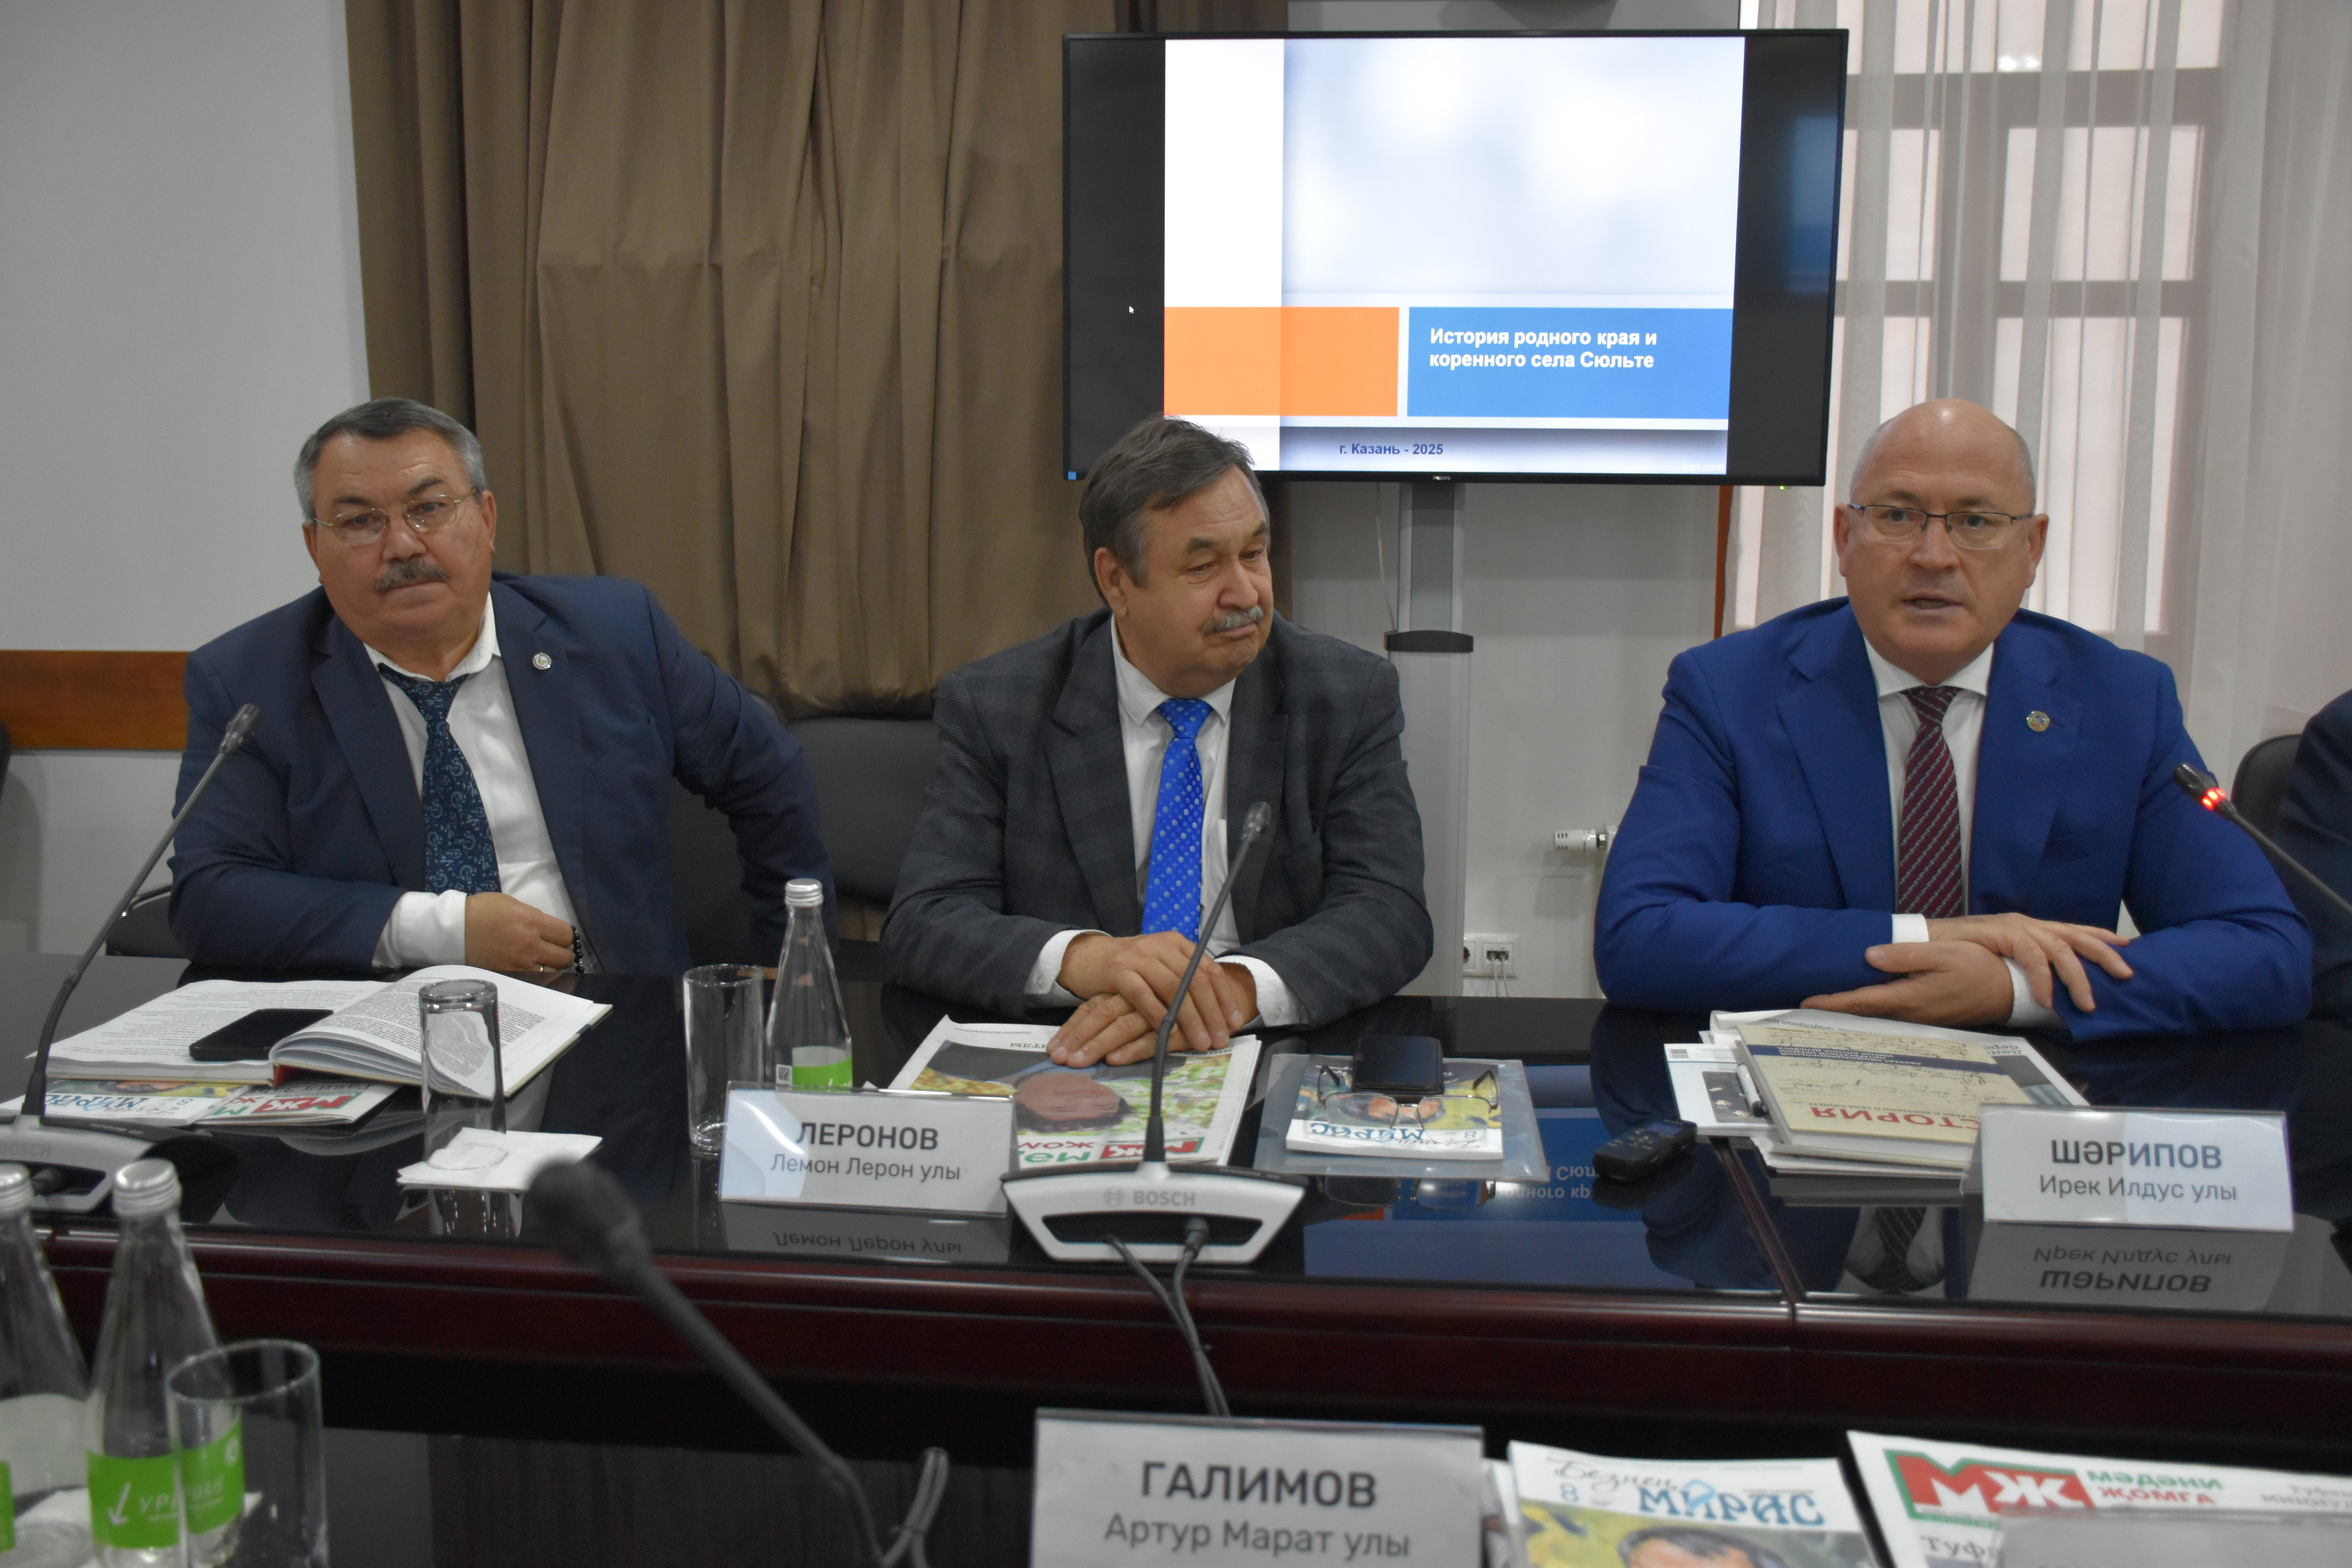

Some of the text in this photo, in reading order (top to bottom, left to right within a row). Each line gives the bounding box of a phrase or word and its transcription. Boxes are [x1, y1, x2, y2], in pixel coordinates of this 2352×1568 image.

[1430, 328, 1657, 348] История родного края и
[1429, 351, 1654, 370] коренного села Сюльте
[1339, 445, 1348, 455] г.
[1350, 442, 1401, 456] Казань
[1412, 443, 1443, 455] 2025
[1815, 1107, 1980, 1131] СТОРИЯ
[796, 1122, 939, 1151] ЛЕРОНОВ
[1463, 1131, 1477, 1140] 8
[2051, 1139, 2222, 1169] ШӘРИПОВ
[771, 1153, 960, 1182] Лемон Лерон улы
[1132, 1189, 1196, 1207] BOSCH
[2039, 1174, 2237, 1203] Ирек Илдус улы
[1139, 1460, 1378, 1509] ГАЛИМОВ
[1560, 1483, 1579, 1502] 8
[1637, 1486, 1826, 1526] МИРАС
[1104, 1513, 1410, 1560] Артур Марат улы
